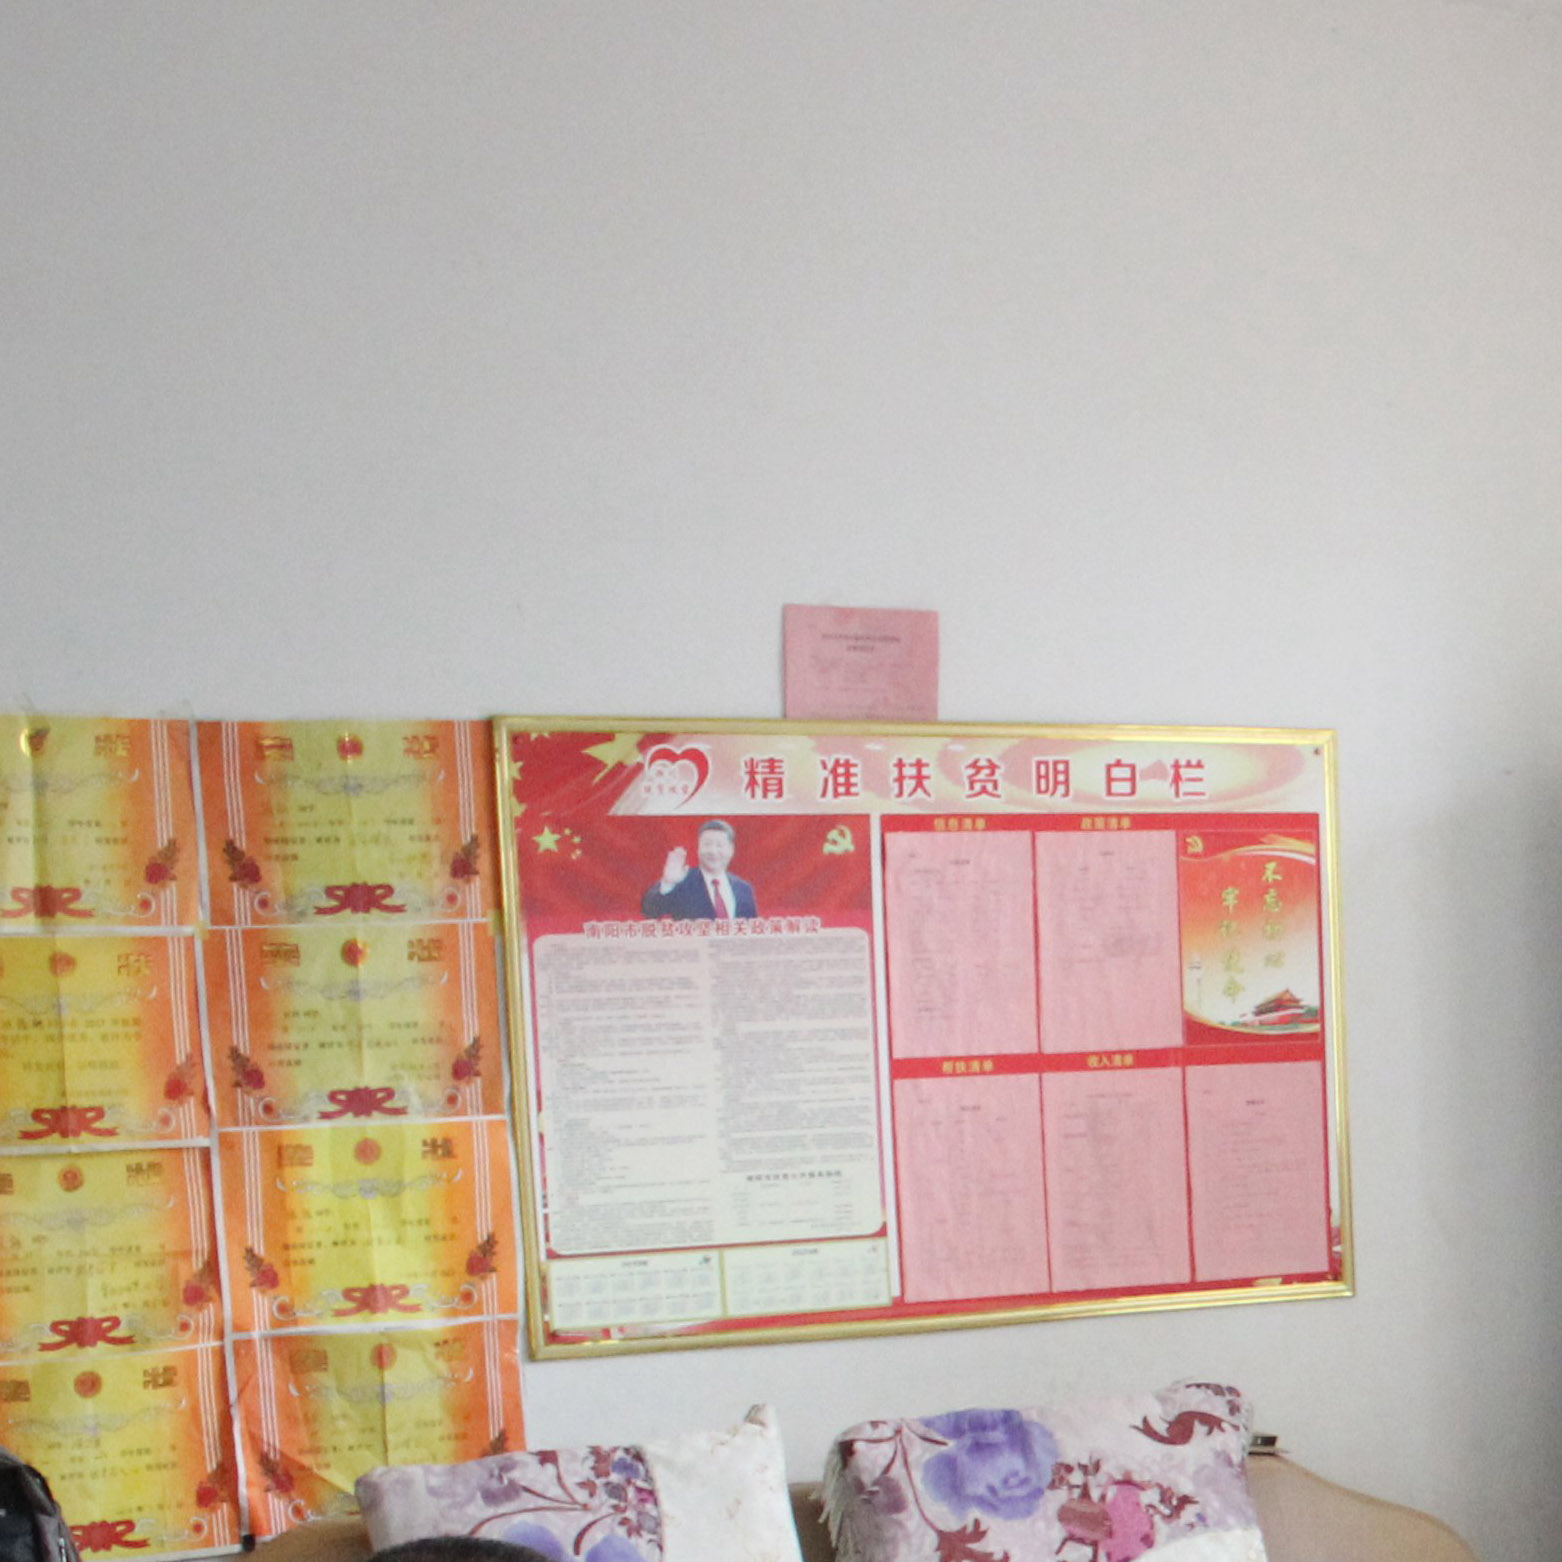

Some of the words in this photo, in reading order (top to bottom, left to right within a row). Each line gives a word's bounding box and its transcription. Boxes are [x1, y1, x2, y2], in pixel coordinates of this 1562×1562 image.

[744, 757, 1206, 799] 精准扶贫明白栏
